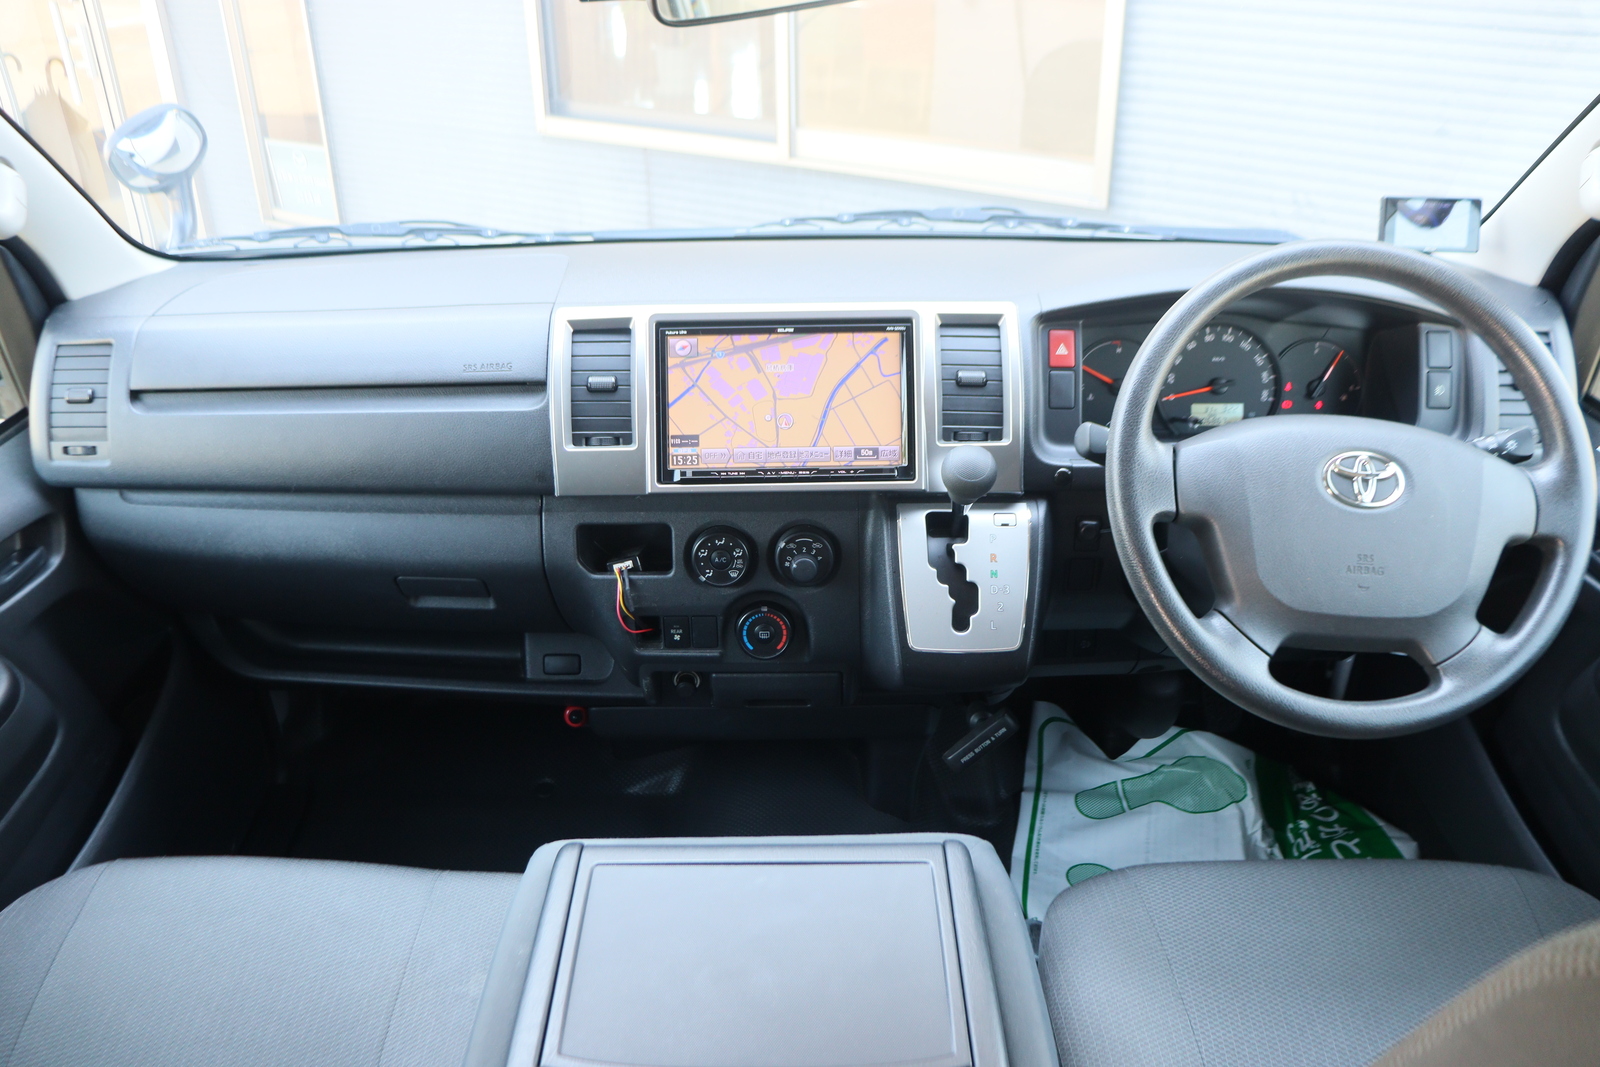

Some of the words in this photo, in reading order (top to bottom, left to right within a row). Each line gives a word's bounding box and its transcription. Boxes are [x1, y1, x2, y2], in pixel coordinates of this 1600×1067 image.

[480, 362, 513, 370] AIRBAG
[672, 455, 698, 466] 15:25
[704, 452, 719, 460] OFF
[989, 534, 997, 543] P
[989, 553, 998, 563] R
[989, 569, 998, 578] N
[1345, 565, 1385, 576] AIRBAG
[997, 601, 1004, 612] 2
[990, 620, 997, 630] L
[960, 752, 975, 764] PRESS
[974, 739, 991, 753] BUTTON
[994, 727, 1007, 738] TURN
